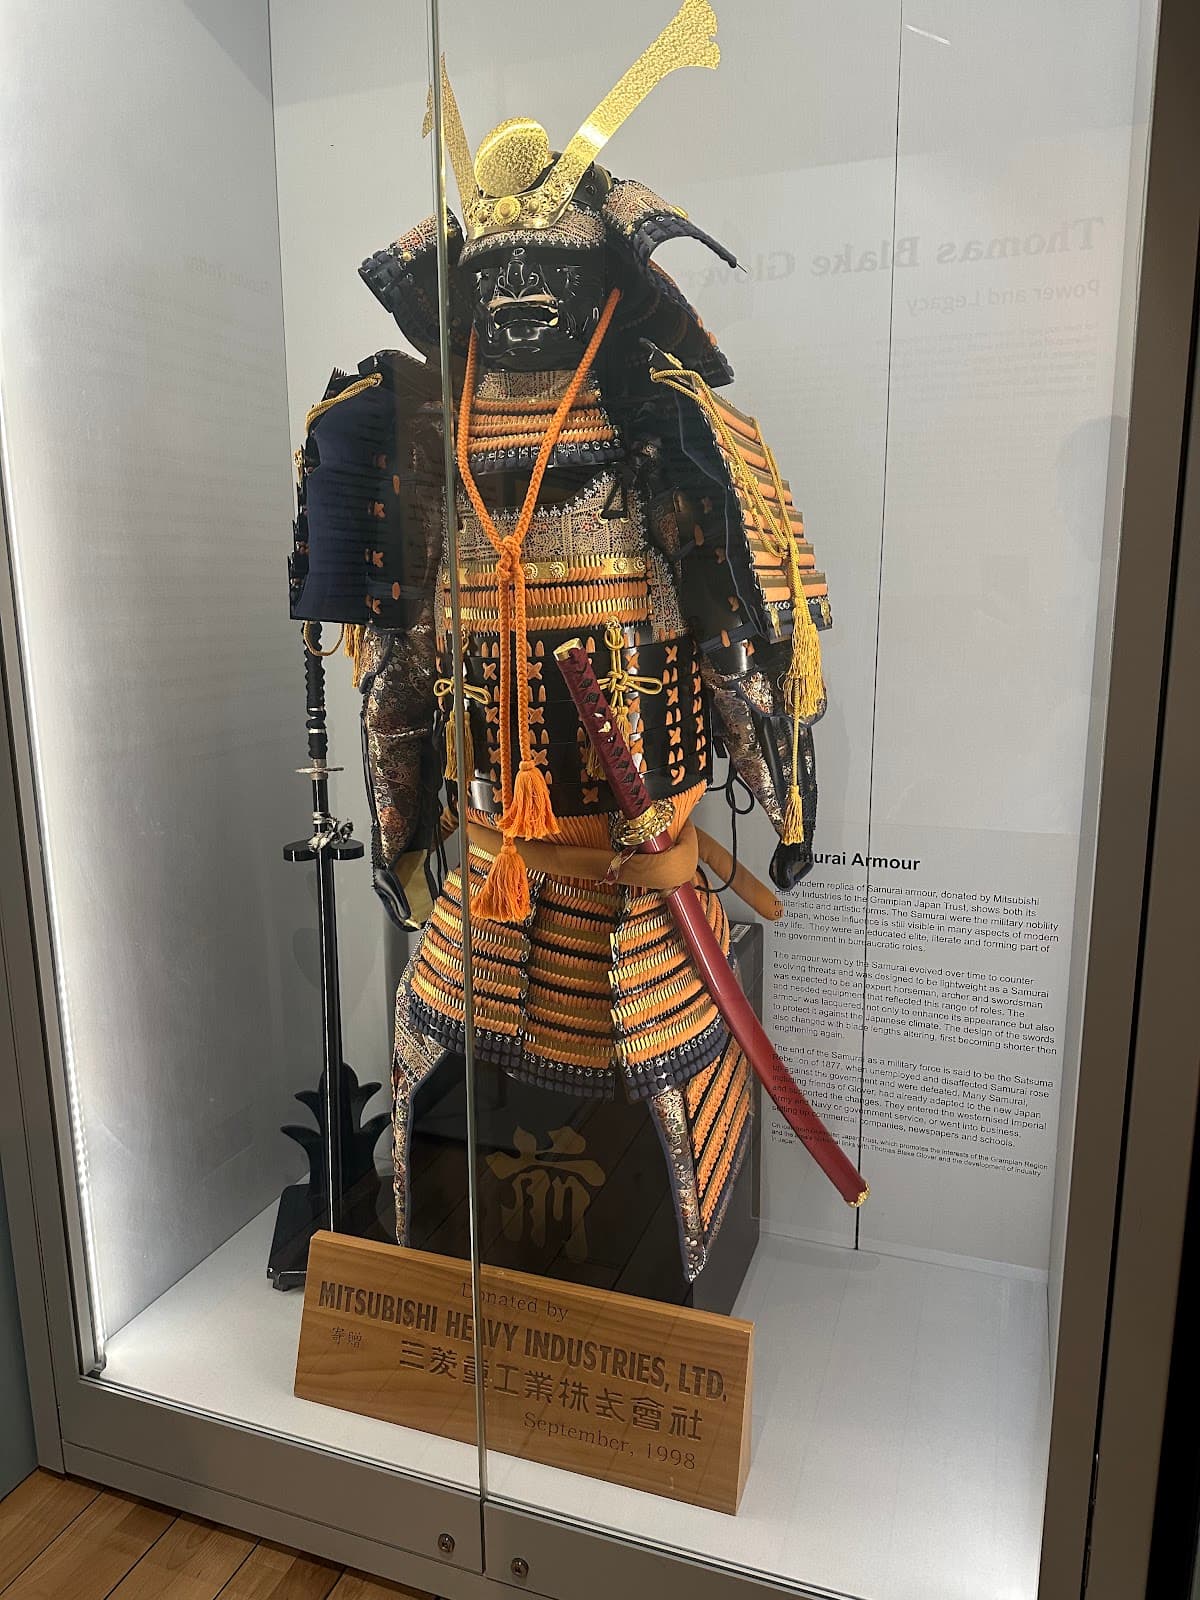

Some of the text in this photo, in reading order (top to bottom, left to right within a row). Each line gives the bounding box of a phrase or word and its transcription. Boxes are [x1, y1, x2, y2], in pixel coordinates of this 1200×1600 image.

[851, 852, 921, 871] Armour
[802, 890, 1037, 917] Industries to Grampian Japan Trust, shows both its
[826, 882, 854, 891] replica
[856, 884, 865, 892] of
[867, 884, 902, 894] Samurai
[905, 889, 938, 899] armour,
[940, 890, 977, 900] donated
[979, 893, 990, 903] by
[783, 910, 1059, 942] Japan, whose is still in many aspects of modern
[833, 904, 1058, 932] artistic The Samurai were the military nobility
[788, 933, 925, 952] government in roles.
[831, 926, 851, 934] were
[867, 928, 906, 939] educated
[908, 932, 928, 942] elite,
[983, 939, 1017, 951] forming
[1020, 943, 1038, 952] part
[1040, 944, 1050, 952] of
[807, 965, 835, 975] threats
[838, 969, 853, 977] and
[874, 972, 913, 983] designed
[1011, 986, 1049, 998] Samurai
[821, 957, 1034, 985] worn evolved over counter
[791, 975, 827, 984] expected
[941, 991, 970, 1001] archer
[971, 994, 988, 1003] and
[991, 997, 1043, 1008] swordsman
[881, 1006, 1055, 1032] only to its appearance but also
[884, 995, 1024, 1018] reflected range of roles. The
[818, 1009, 1054, 1043] against climate. design of the swords
[819, 1030, 844, 1038] again.
[940, 1033, 1056, 1055] first becoming shorter then
[806, 1048, 815, 1056] of
[887, 1058, 917, 1071] military
[919, 1062, 941, 1073] force
[943, 1066, 950, 1074] is
[952, 1068, 970, 1077] said
[973, 1069, 981, 1078] to
[997, 1073, 1011, 1082] the
[1013, 1075, 1053, 1088] Satsuma
[821, 1059, 1049, 1098] 1877, and disaffected Samurai rose
[837, 1083, 845, 1091] of
[896, 1091, 927, 1105] already
[977, 1102, 991, 1112] the
[993, 1106, 1011, 1115] new
[1014, 1107, 1041, 1119] Japan
[879, 1079, 894, 1087] and
[897, 1082, 918, 1091] were
[920, 1084, 959, 1097] defeated.
[962, 1089, 986, 1102] Many
[811, 1099, 831, 1111] Navy
[939, 1120, 960, 1129] went
[962, 1121, 977, 1131] into
[980, 1124, 1021, 1138] business.
[829, 1092, 1046, 1130] the They entered westernised Imperial
[908, 1125, 958, 1139] newspapers
[961, 1133, 977, 1141] and
[979, 1135, 1015, 1147] schools.
[460, 1281, 569, 1323] Dnated by
[318, 1280, 439, 1333] MITSUBISHI
[523, 1327, 670, 1393] INDUSTRIES,
[678, 1362, 727, 1402] LTD.
[523, 1410, 696, 1471] September, 1998
